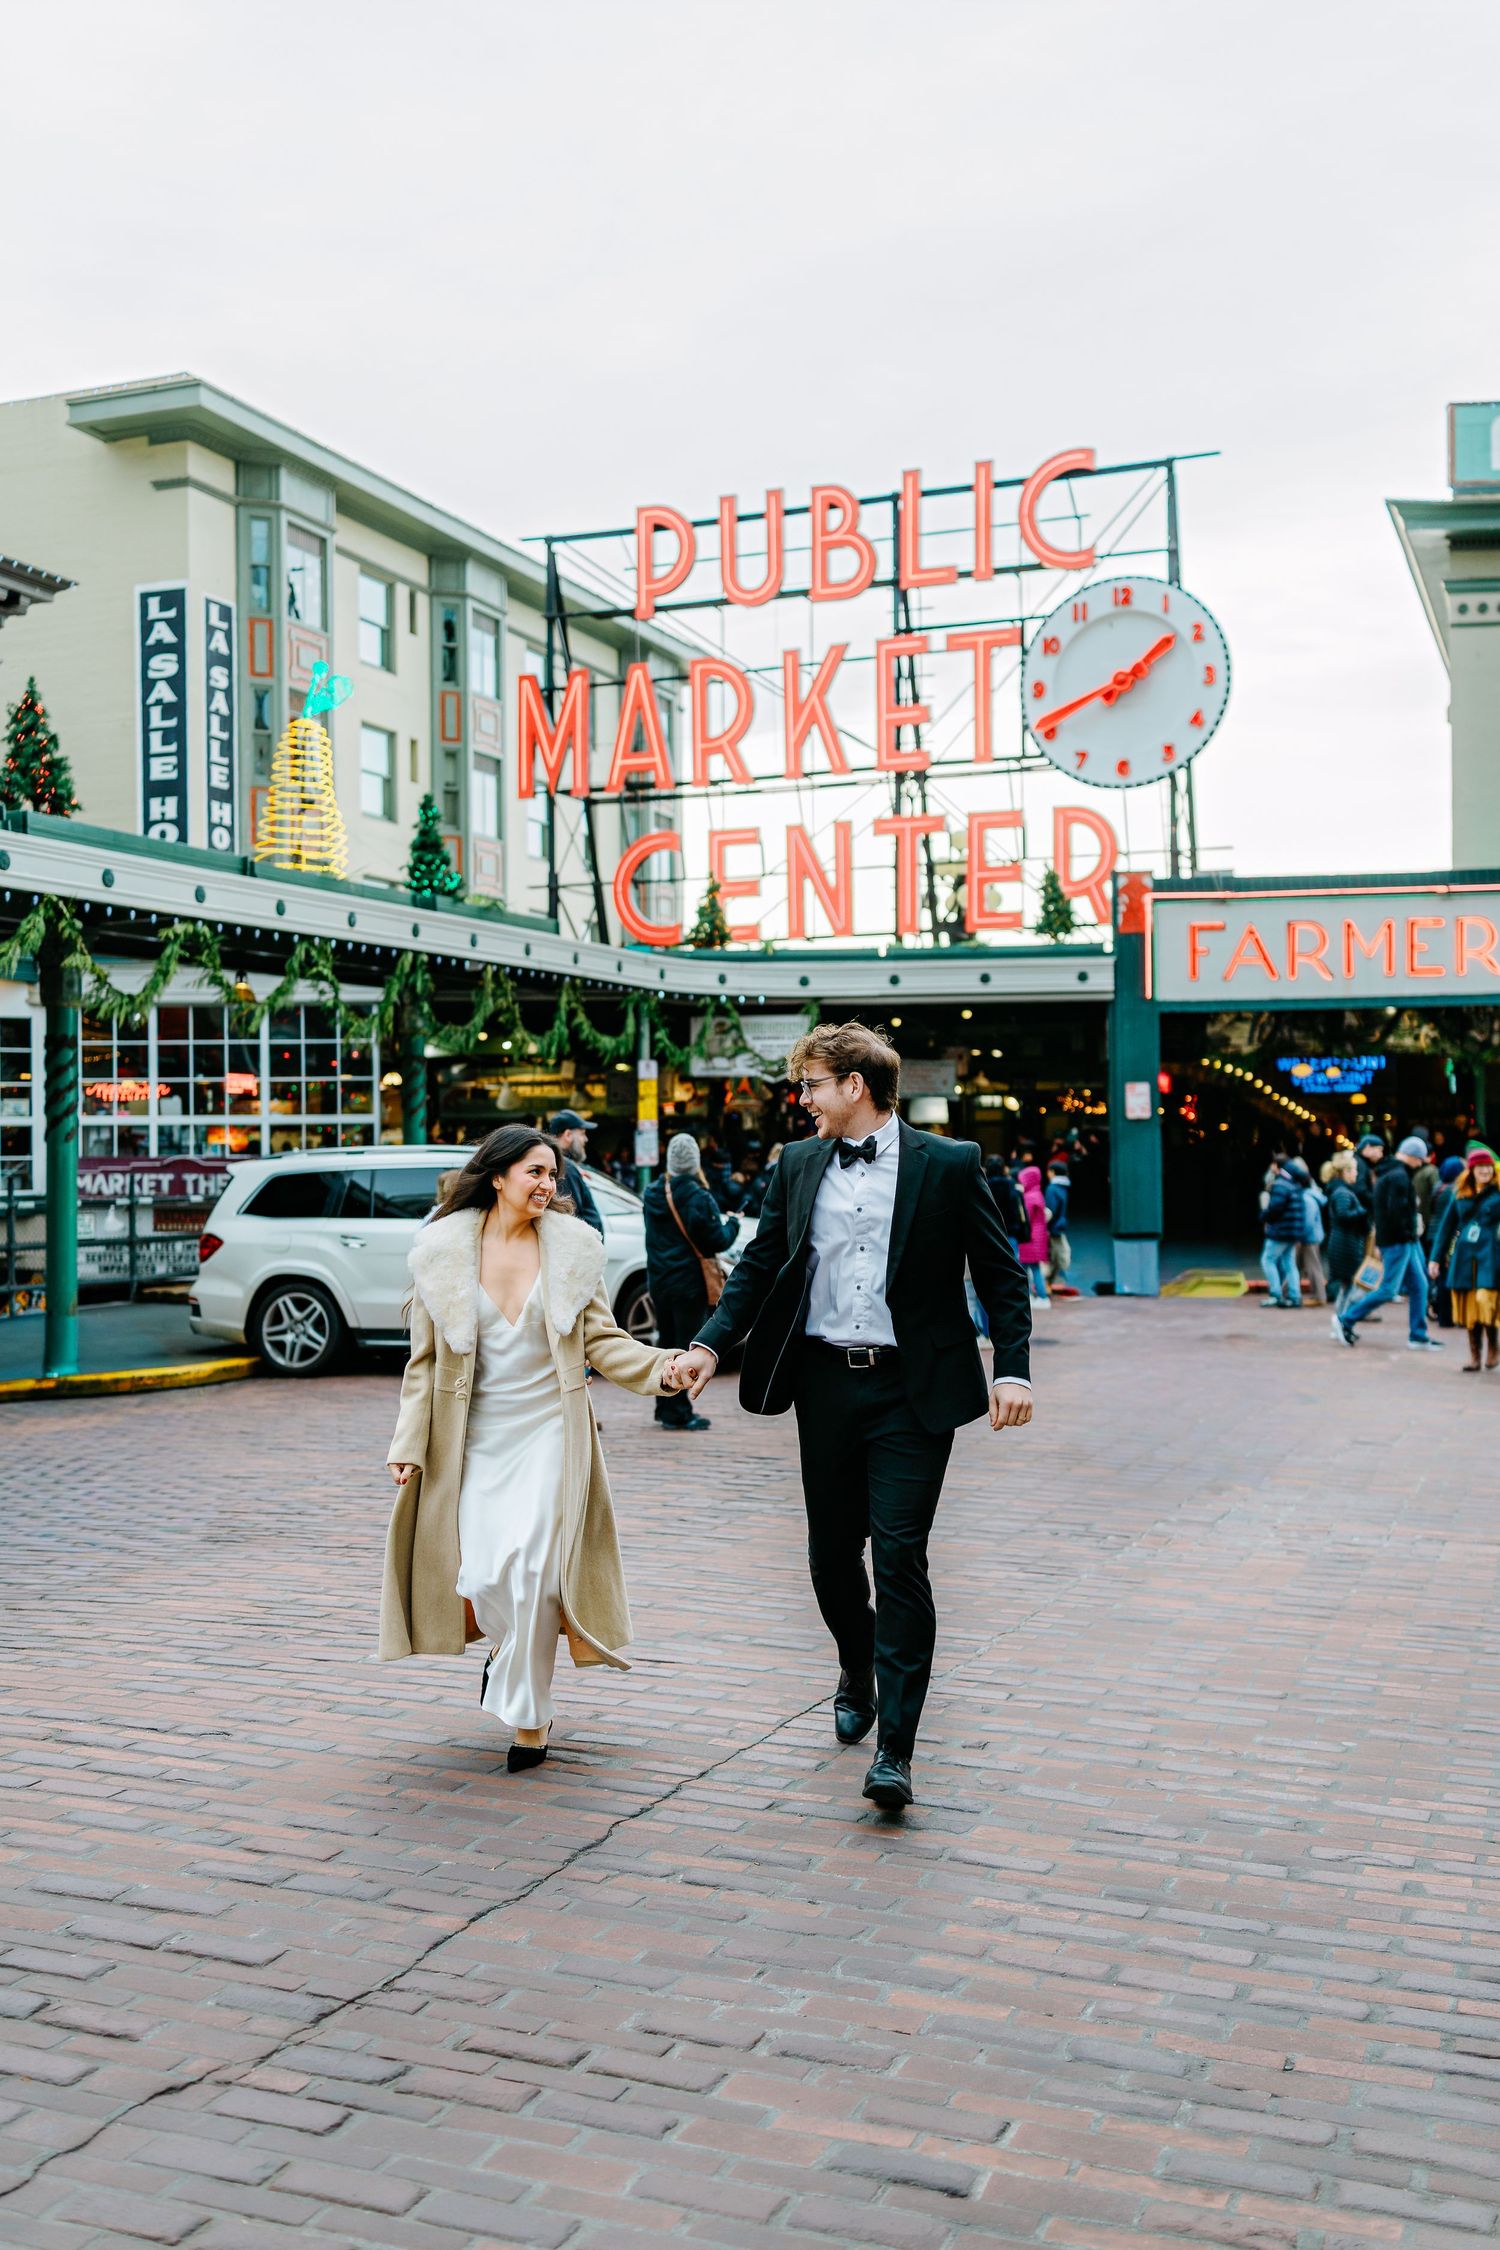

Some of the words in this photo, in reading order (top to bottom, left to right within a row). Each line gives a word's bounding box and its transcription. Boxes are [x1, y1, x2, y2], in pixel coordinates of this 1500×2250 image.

[635, 449, 1096, 620] PUBLIC
[1113, 587, 1132, 606] 12
[1163, 594, 1169, 613] 1
[145, 595, 178, 646] LA
[1073, 602, 1087, 622] 11
[208, 603, 230, 656] LA
[1192, 623, 1204, 641] 2
[1043, 637, 1060, 655] 10
[1203, 664, 1215, 685] 3
[1032, 681, 1045, 699] 9
[145, 653, 179, 781] SALLE
[517, 627, 1021, 799] MARKET
[1189, 708, 1205, 729] 4
[208, 665, 231, 791] SALLE
[1075, 751, 1088, 769] 7
[1162, 743, 1175, 762] 5
[1116, 758, 1130, 777] 6
[210, 800, 232, 851] HO
[613, 807, 1118, 945] CENTER
[1188, 916, 1500, 981] FARMER
[77, 1173, 174, 1195] MARKET
